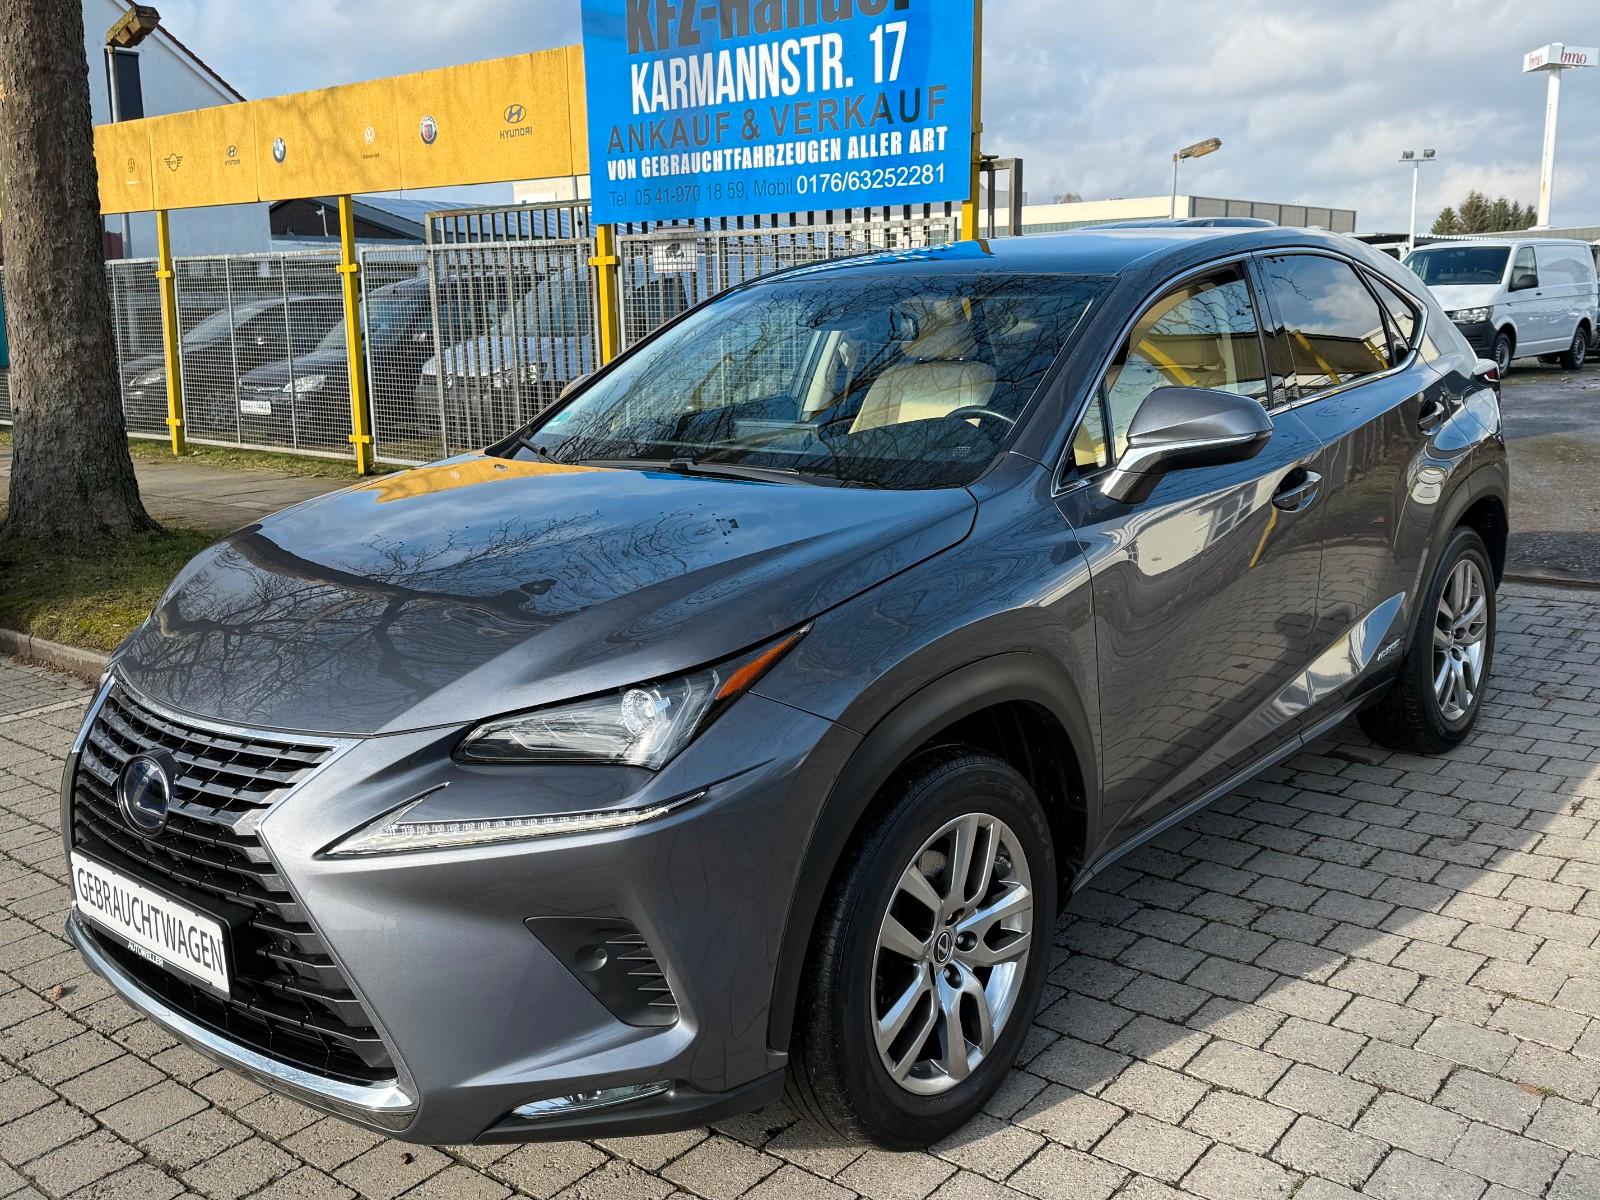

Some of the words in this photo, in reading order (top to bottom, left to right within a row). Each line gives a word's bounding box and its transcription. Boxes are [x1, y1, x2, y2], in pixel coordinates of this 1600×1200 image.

[631, 32, 853, 114] KARMANNSTR.
[869, 20, 907, 84] 17
[1560, 46, 1587, 65] bmo
[499, 126, 533, 140] HYUNDAI
[607, 111, 731, 155] ANKAUF
[741, 108, 761, 141] &
[769, 84, 948, 137] VERKAUF
[607, 158, 637, 181] VON
[641, 137, 842, 179] GEBRAUCHTFAHRZEUGEN
[847, 131, 903, 161] ALLER
[909, 126, 948, 154] ART
[610, 191, 631, 208] Tel.
[655, 184, 701, 205] 41-970
[706, 183, 722, 201] 18
[754, 177, 793, 197] Mobil
[796, 162, 945, 195] 0176/63252281
[77, 867, 224, 976] GEBRAUCHTWAGEN
